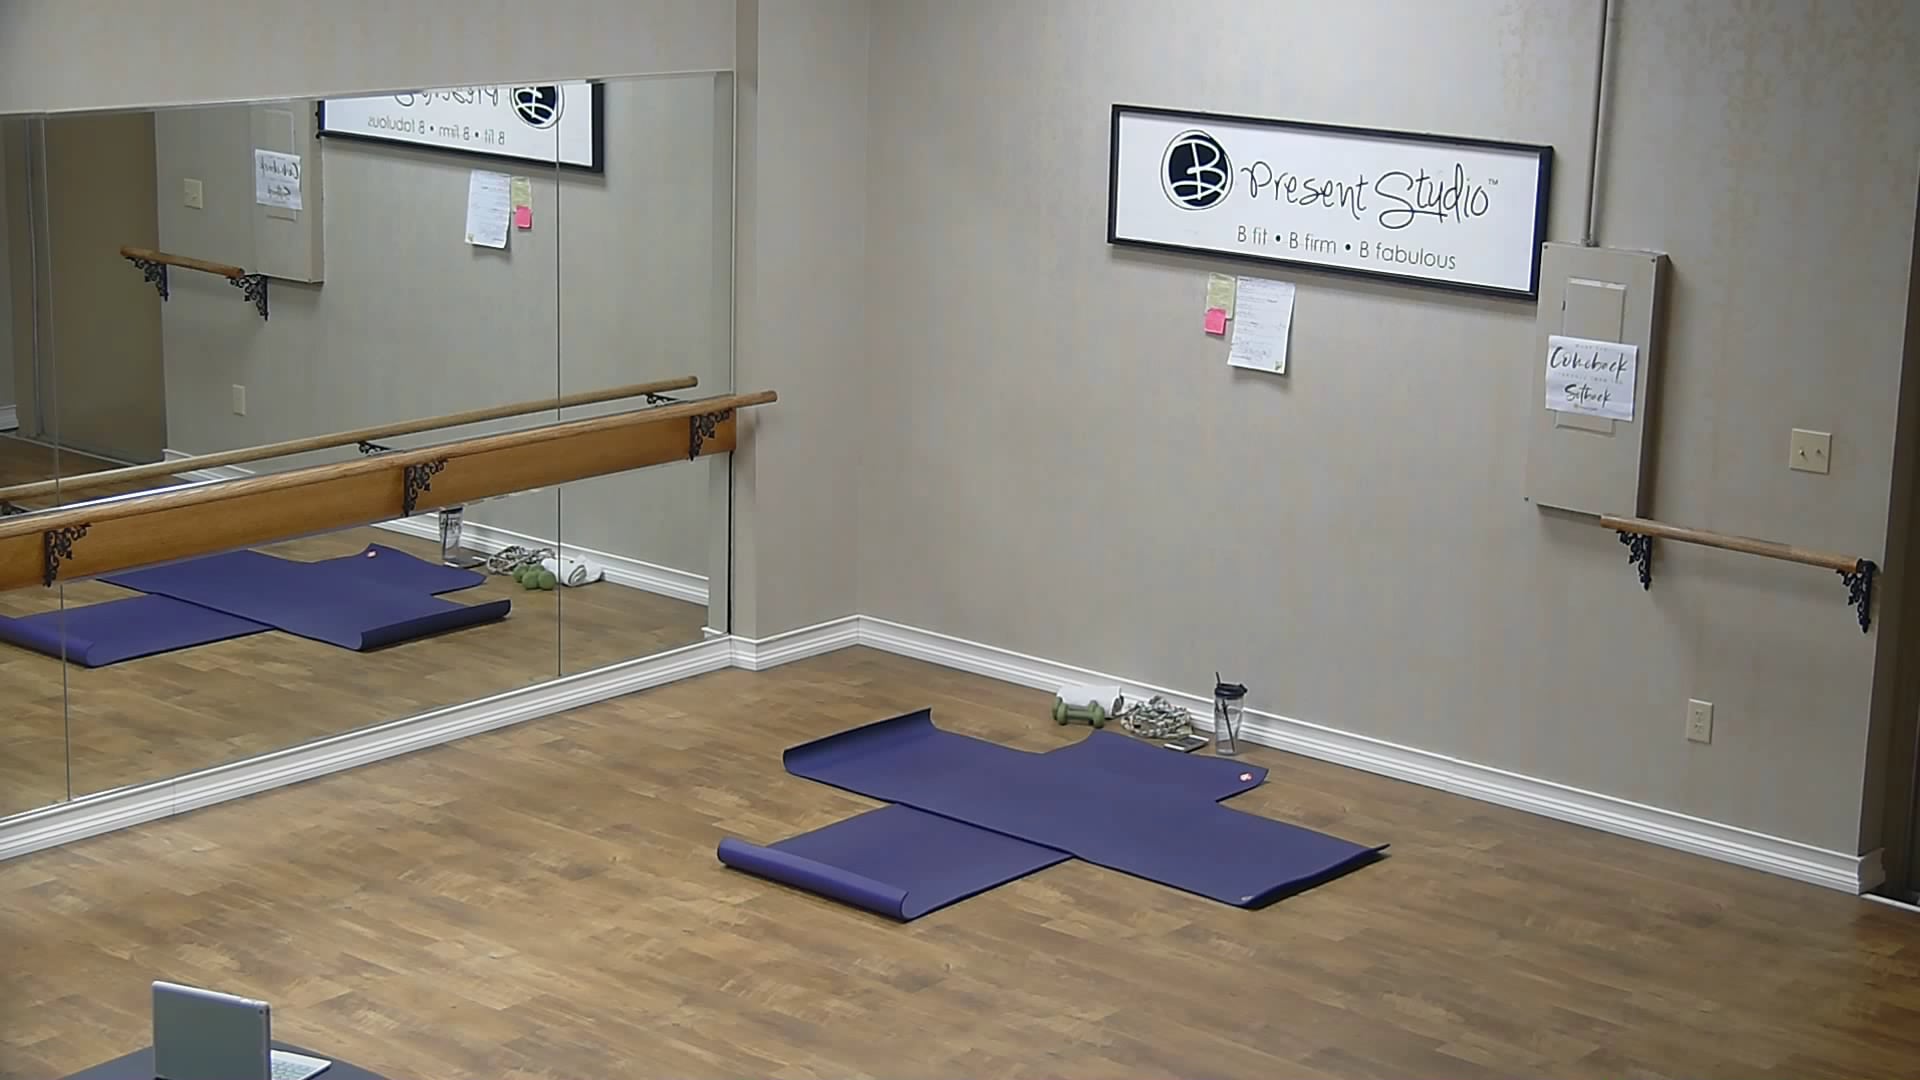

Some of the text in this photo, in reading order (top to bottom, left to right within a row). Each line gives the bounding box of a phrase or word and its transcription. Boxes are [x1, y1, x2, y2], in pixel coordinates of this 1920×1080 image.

[1241, 160, 1369, 220] Present
[1375, 163, 1490, 229] Studio
[1237, 225, 1457, 271] B fit B firm B fabulous
